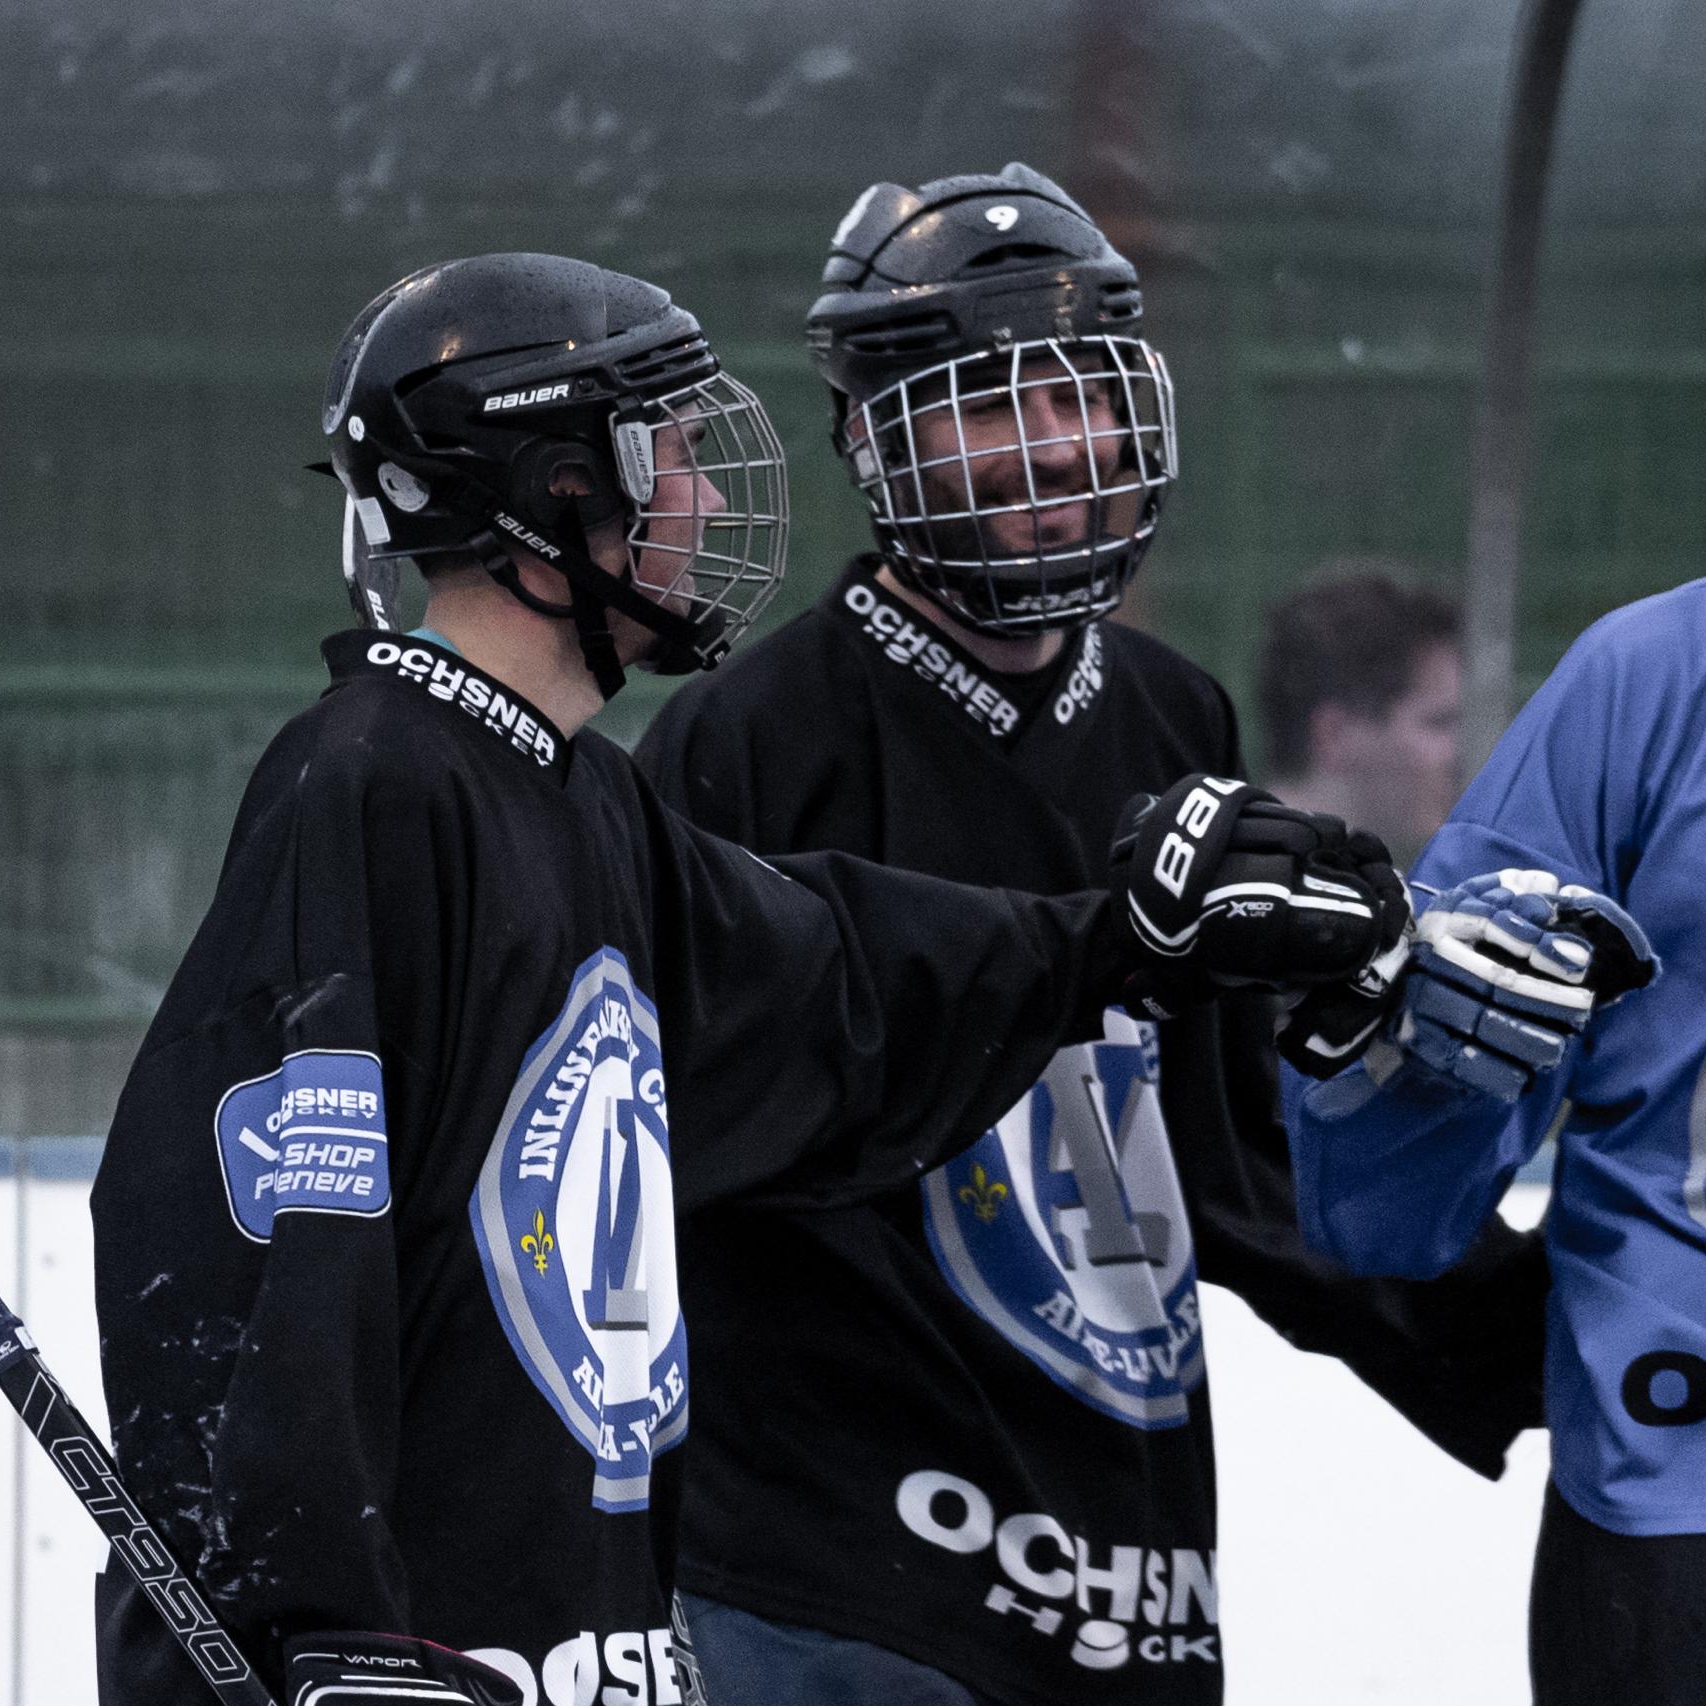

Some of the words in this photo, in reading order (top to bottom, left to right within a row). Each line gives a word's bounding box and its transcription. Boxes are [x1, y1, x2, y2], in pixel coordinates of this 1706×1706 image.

[365, 587, 391, 631] BLA
[366, 641, 555, 763] OCHSNER
[844, 584, 1020, 733] OCHSNER
[283, 1142, 376, 1169] SHOP
[895, 1469, 1219, 1627] OCHSN
[343, 1653, 423, 1668] VAPOR
[983, 1583, 1218, 1671] HOCK
